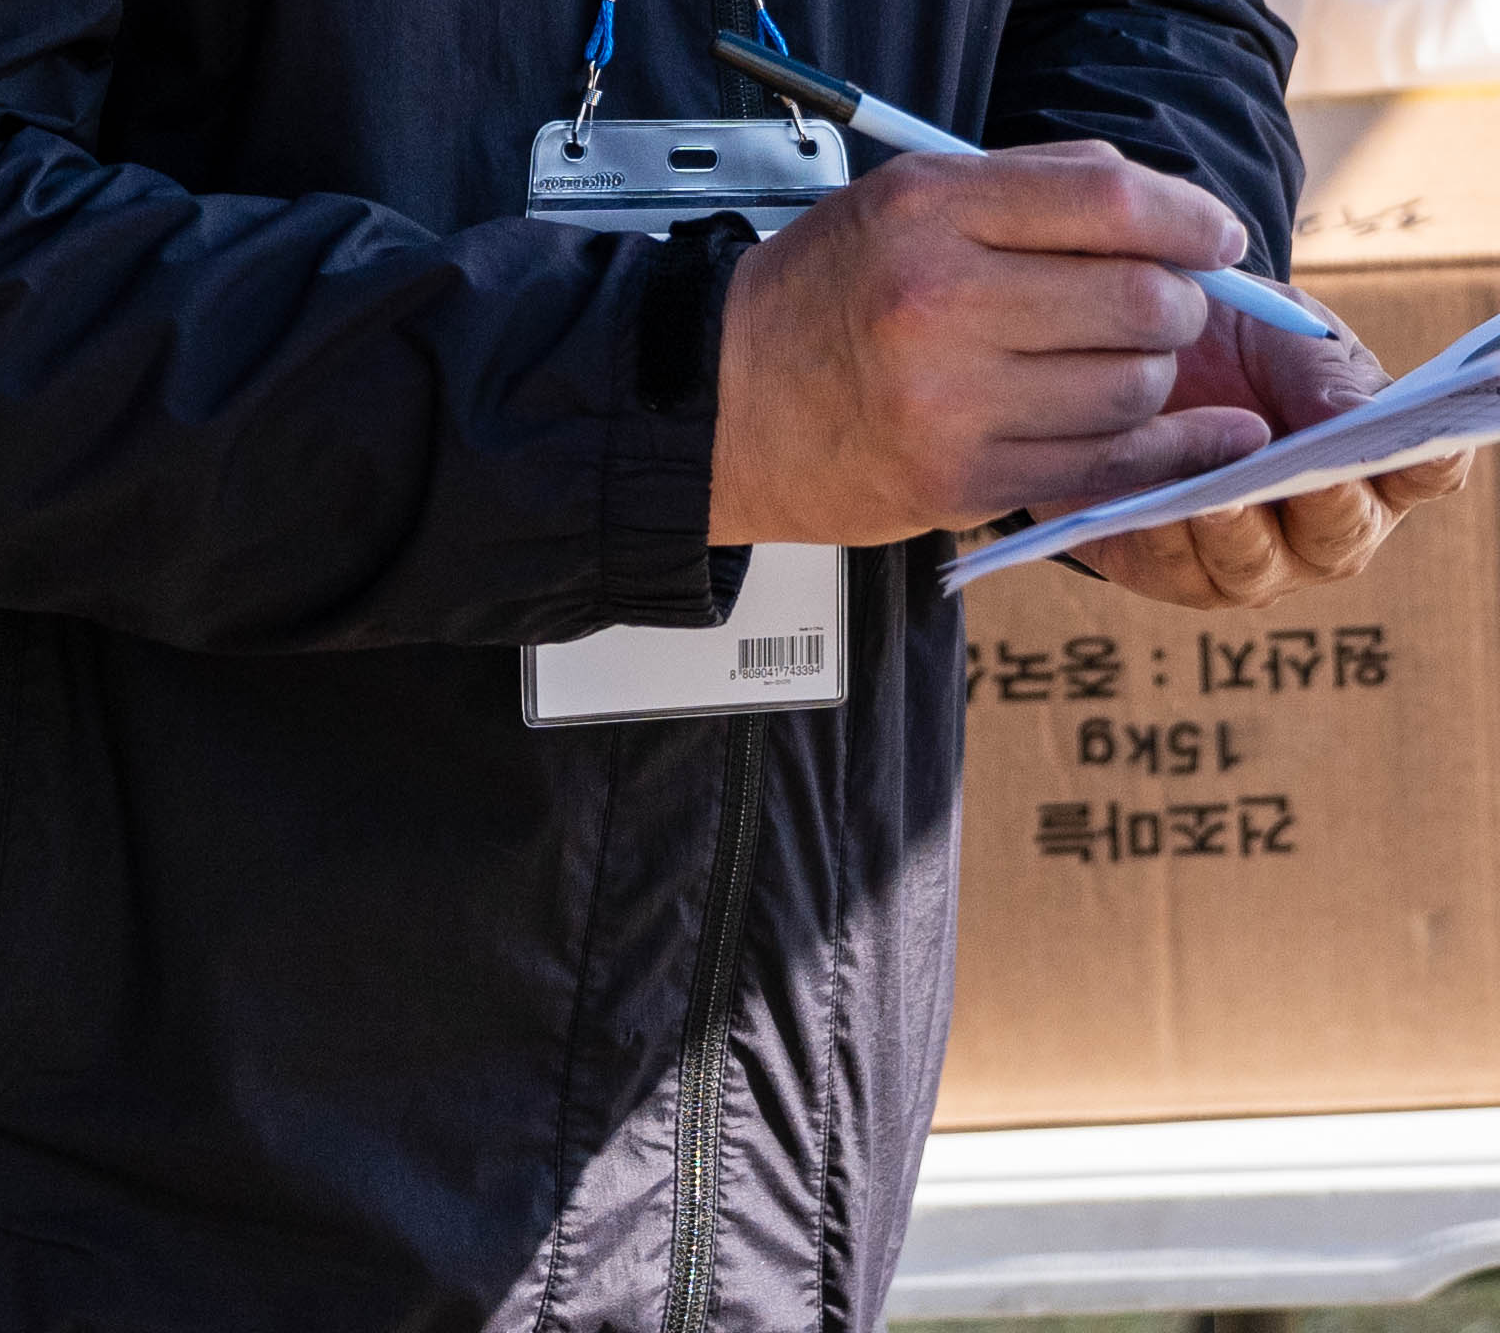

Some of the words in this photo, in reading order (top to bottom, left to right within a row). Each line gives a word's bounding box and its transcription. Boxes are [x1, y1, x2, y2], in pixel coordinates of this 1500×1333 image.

[729, 669, 737, 681] 8
[742, 666, 780, 680] 809041
[783, 664, 821, 678] 743394
[1199, 625, 1390, 695] 원산지
[1077, 717, 1242, 777] 15kg
[1035, 794, 1296, 864] 건조마늘
